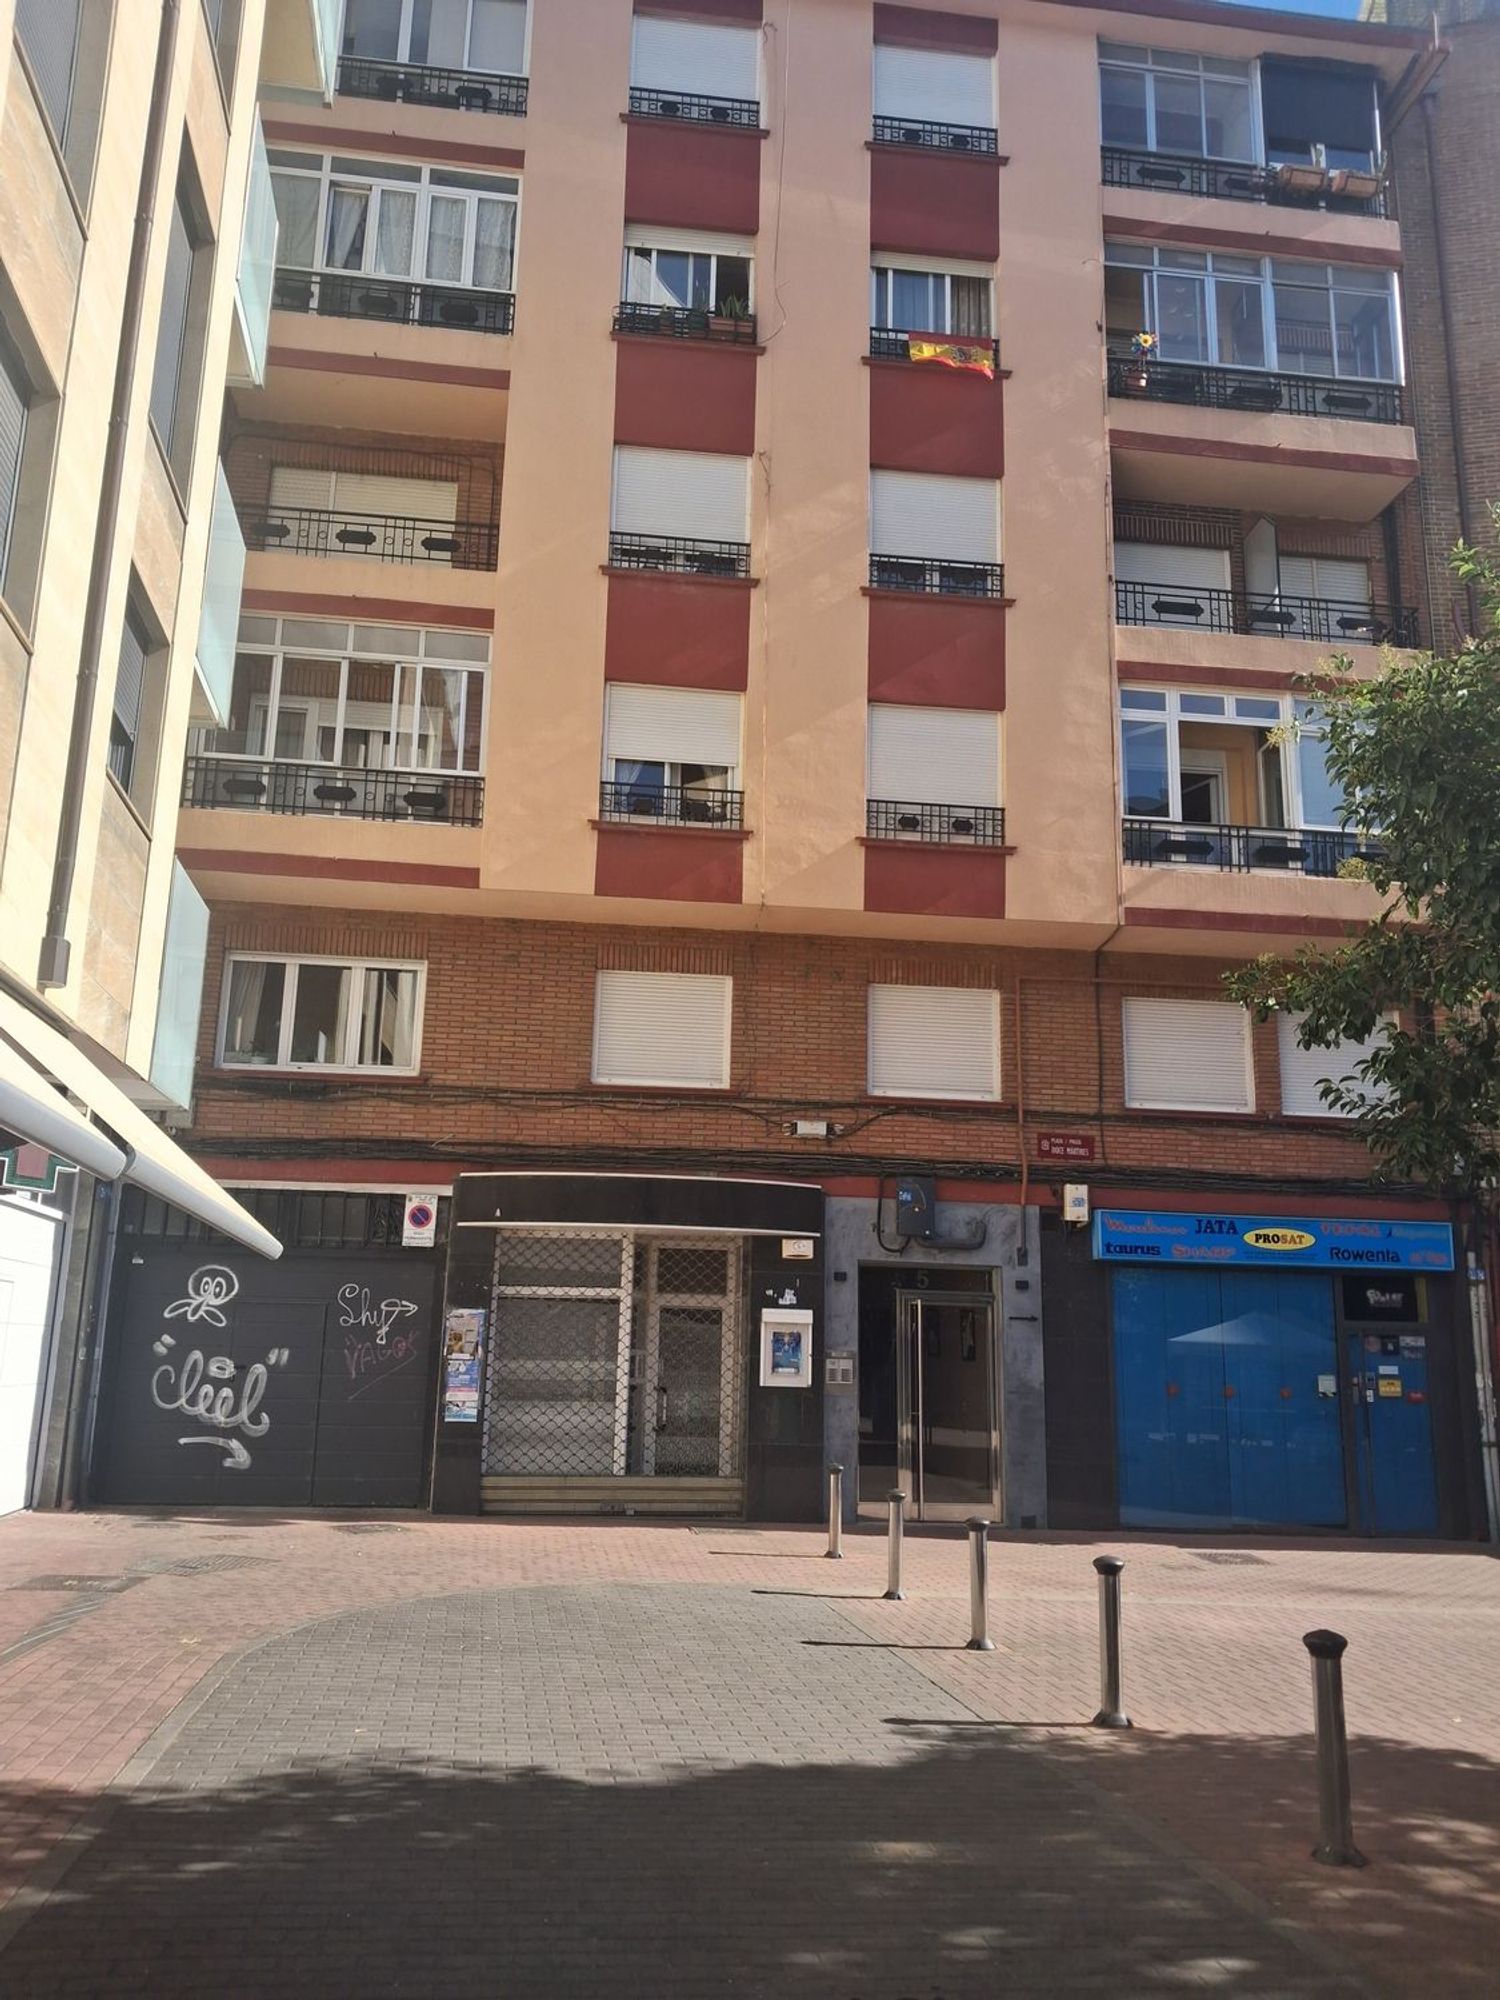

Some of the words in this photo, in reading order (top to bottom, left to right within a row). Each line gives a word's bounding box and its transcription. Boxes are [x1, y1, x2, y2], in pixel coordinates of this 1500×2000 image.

[1195, 1219, 1239, 1235] JATA
[1254, 1233, 1305, 1246] PROSAT
[1105, 1242, 1161, 1256] taurus
[1329, 1246, 1401, 1263] Rowenta
[917, 1269, 930, 1289] 5
